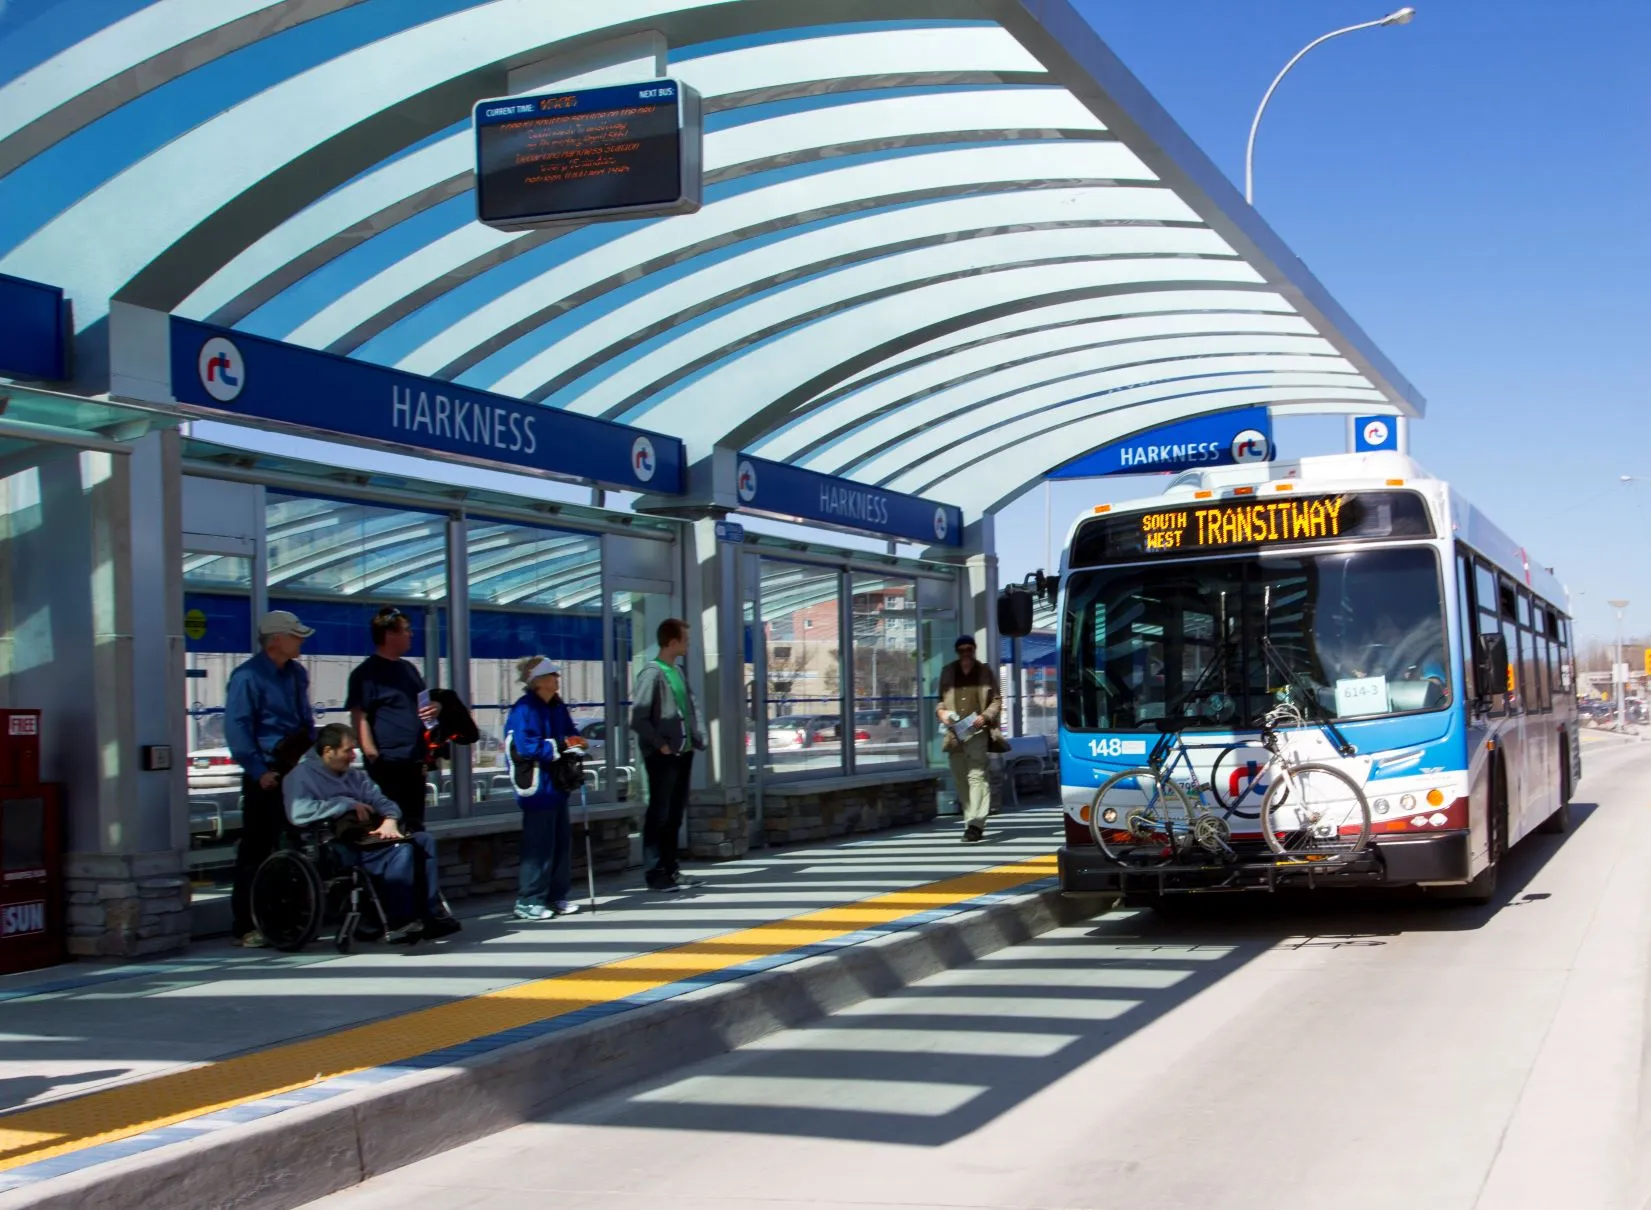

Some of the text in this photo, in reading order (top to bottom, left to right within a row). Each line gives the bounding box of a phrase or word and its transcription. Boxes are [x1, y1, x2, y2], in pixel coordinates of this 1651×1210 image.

[639, 88, 657, 98] NEXT
[486, 105, 515, 117] CURRENT
[392, 384, 537, 454] HARKNESS
[1120, 442, 1220, 466] HARKNESS
[819, 483, 888, 525] HARKNESS
[1142, 498, 1343, 545] SOUTH TRANSITWAY
[1146, 532, 1183, 549] WEST
[1344, 684, 1379, 698] 614-3
[1088, 738, 1122, 757] 148
[5, 902, 44, 934] SUN
